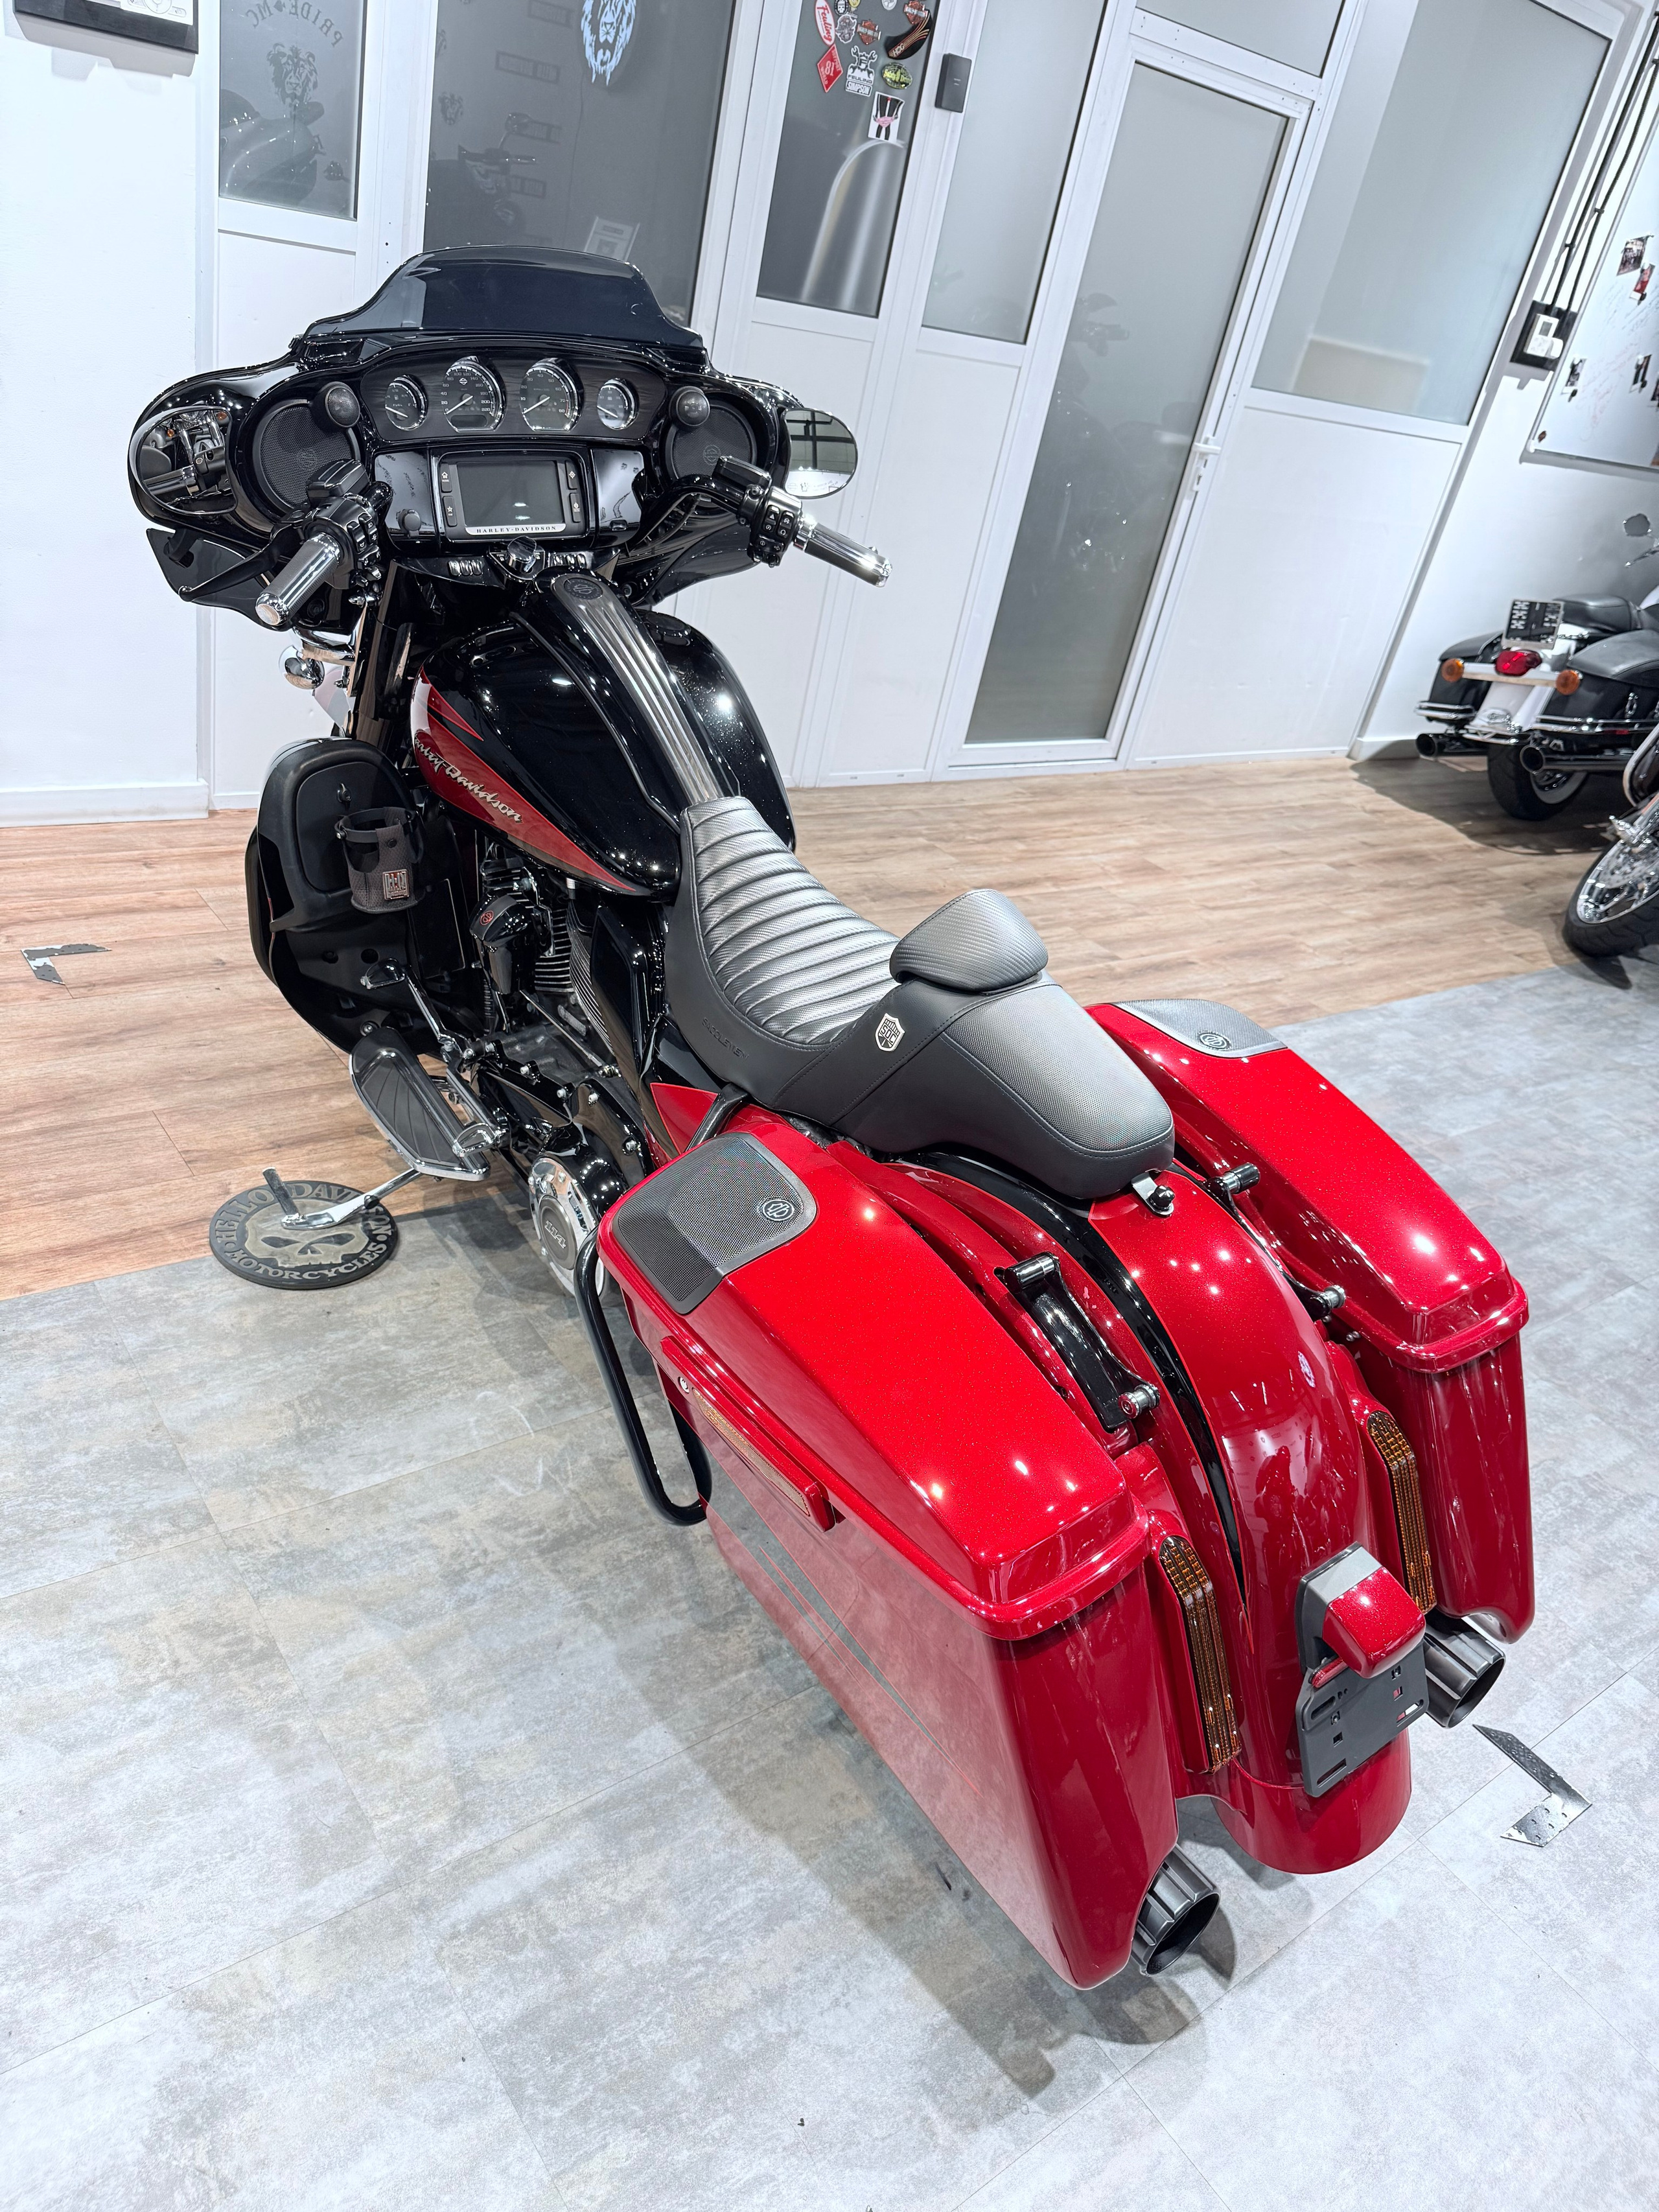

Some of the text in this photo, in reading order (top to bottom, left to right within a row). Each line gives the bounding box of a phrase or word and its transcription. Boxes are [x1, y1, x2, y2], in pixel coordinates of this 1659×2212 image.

[817, 5, 833, 42] Feuling
[892, 43, 905, 56] HOG
[825, 60, 835, 76] 81
[847, 82, 870, 95] SIMPSON
[415, 734, 522, 822] arley-Davidson
[215, 1183, 392, 1244] HELLO DAVISON
[544, 1220, 566, 1249] 114
[225, 1242, 387, 1281] MOTORCYCLES
